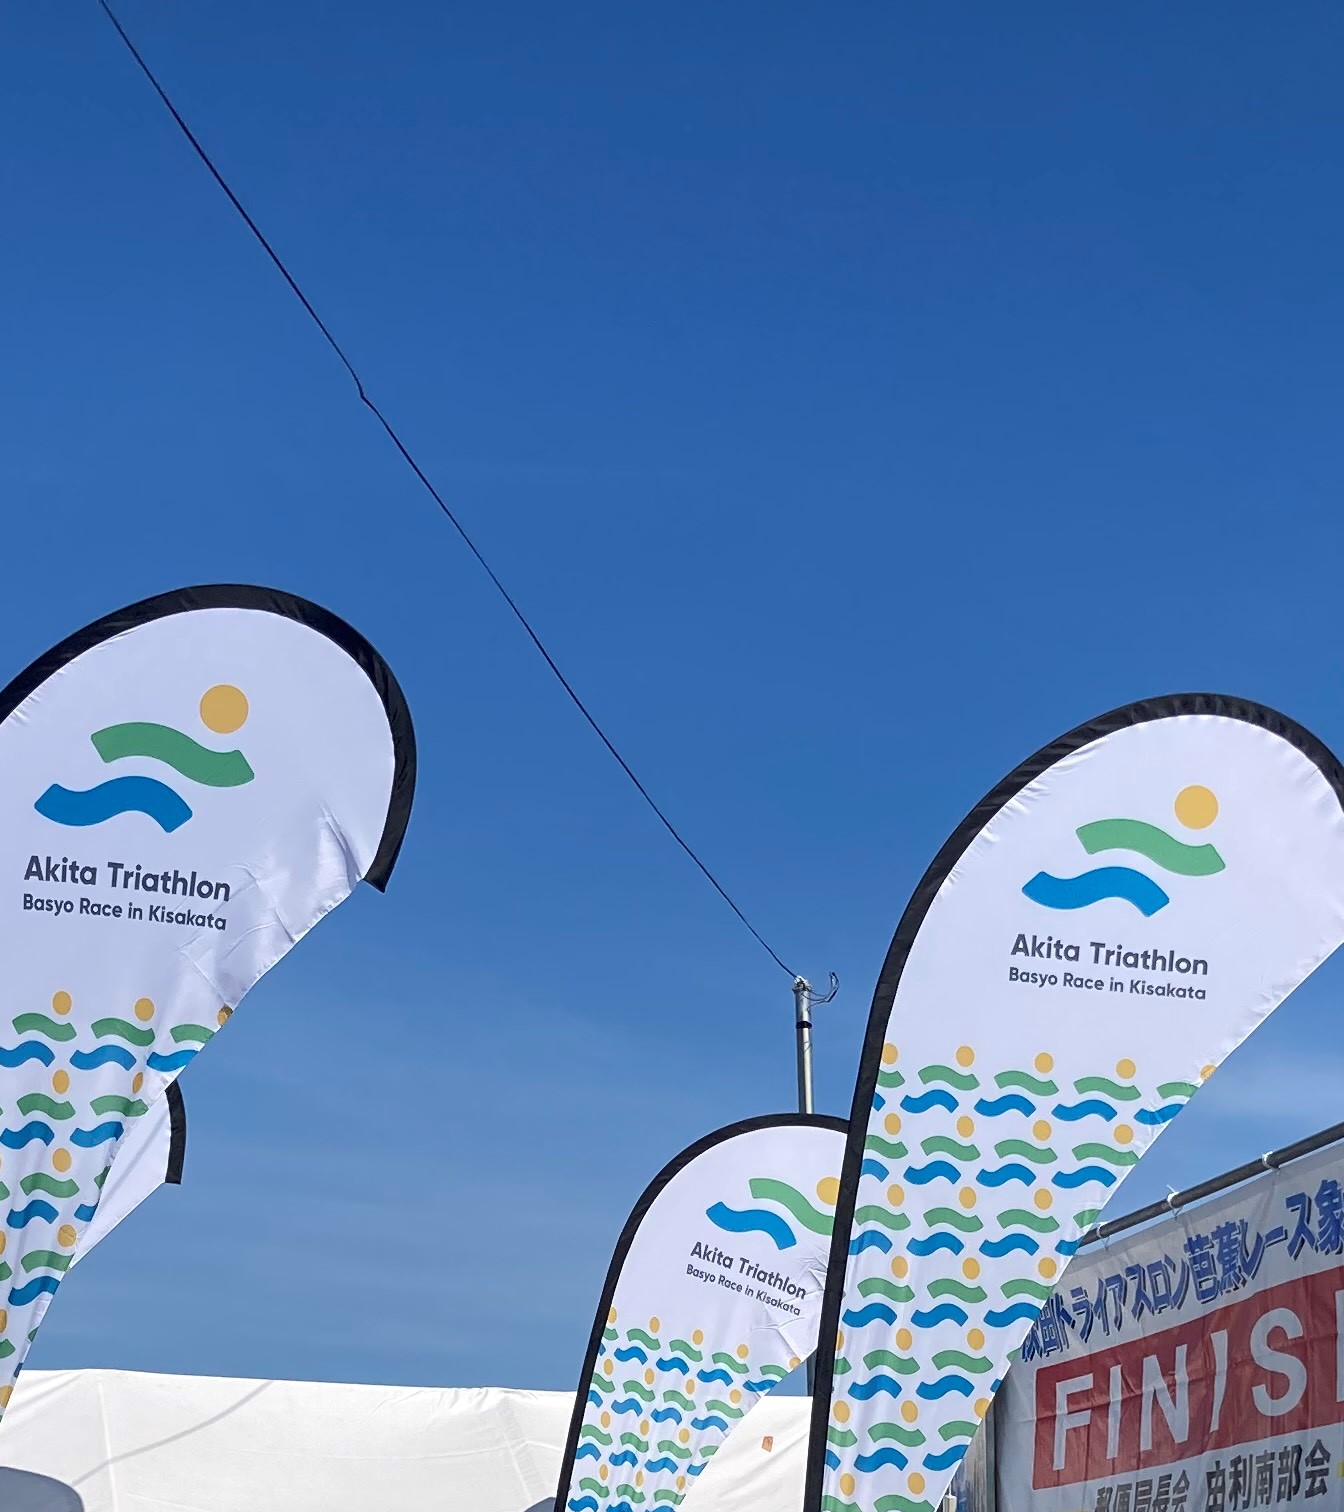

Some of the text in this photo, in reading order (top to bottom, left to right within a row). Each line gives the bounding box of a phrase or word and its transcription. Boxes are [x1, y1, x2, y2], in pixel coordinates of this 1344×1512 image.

[23, 855, 231, 902] Akita Triathlon
[23, 893, 227, 931] Basyo Race in Kisakata
[1010, 933, 1208, 976] Akita Triathlon
[1008, 967, 1207, 1000] Basyo Race in Kisakata
[686, 1264, 801, 1317] Basyo Race in Kisakata
[690, 1241, 807, 1300] Akita Triathlon
